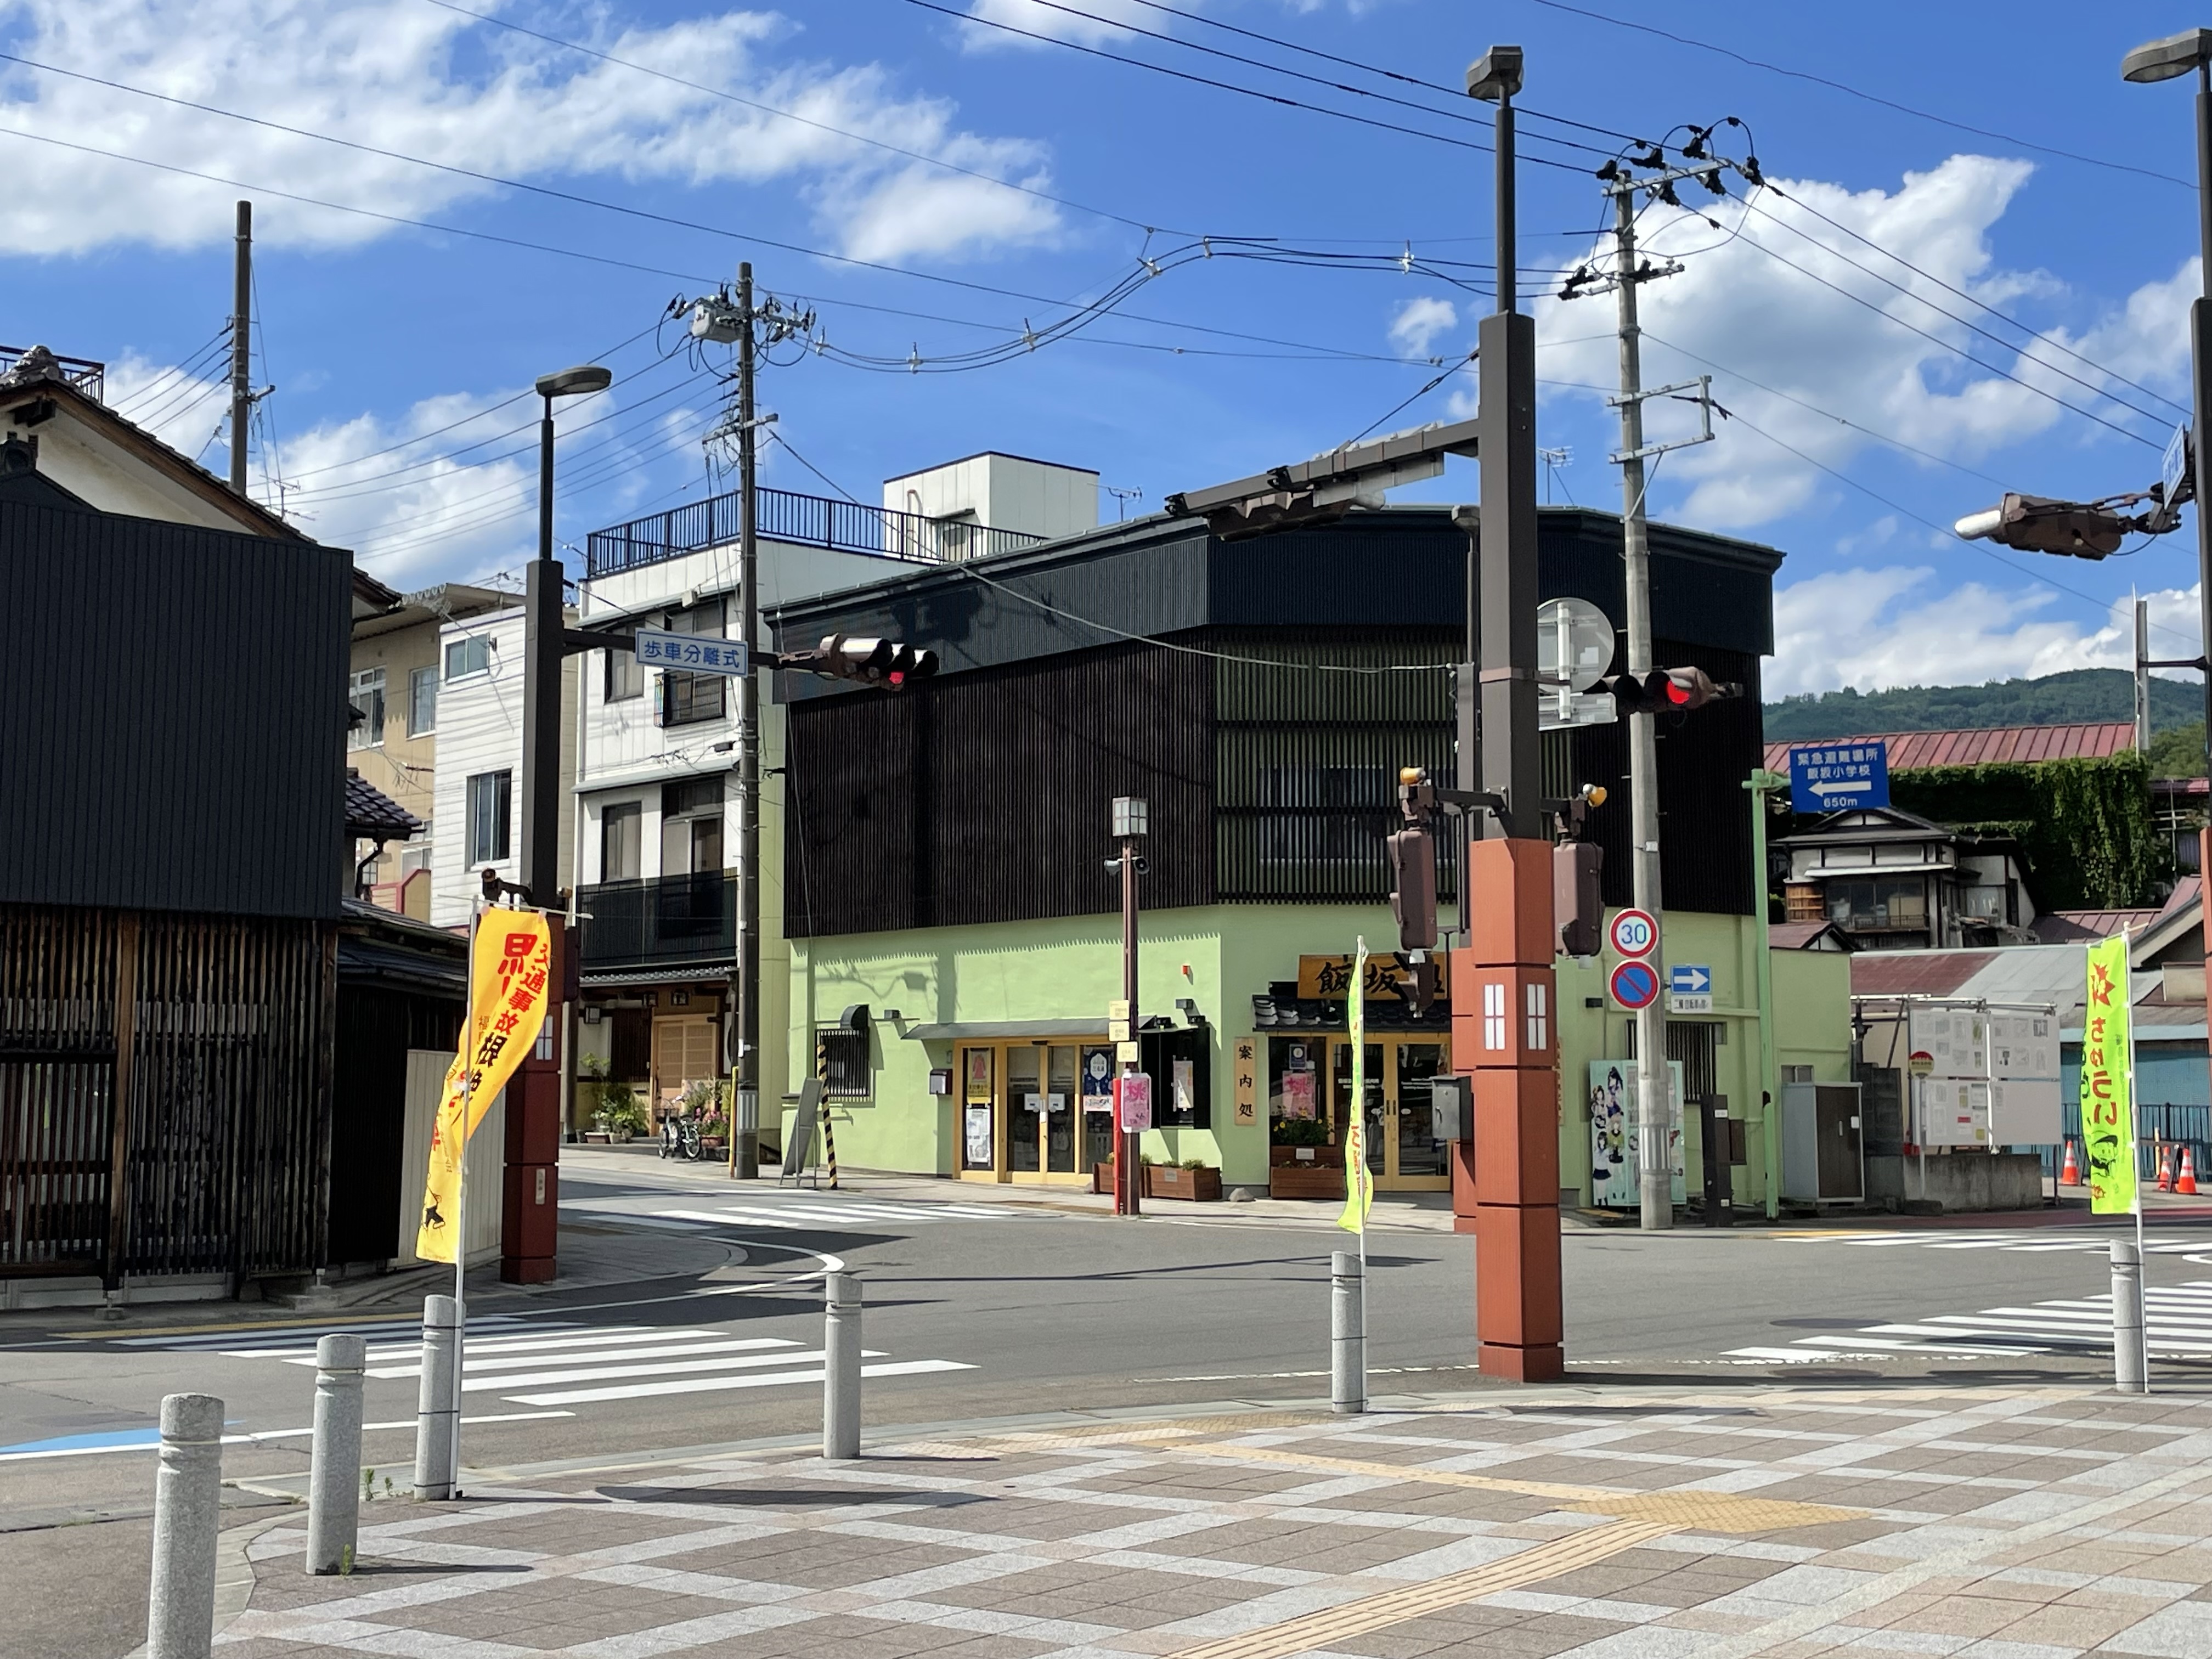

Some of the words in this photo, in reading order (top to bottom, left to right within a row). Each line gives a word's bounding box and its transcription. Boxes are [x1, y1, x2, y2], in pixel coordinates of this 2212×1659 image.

[644, 641, 740, 668] 歩車分離式
[1807, 764, 1871, 780] 飯坂小学校
[1824, 797, 1858, 808] 650m
[1621, 924, 1646, 944] 30
[1315, 962, 1445, 994] 飯坂
[1238, 1045, 1253, 1117] 案内処
